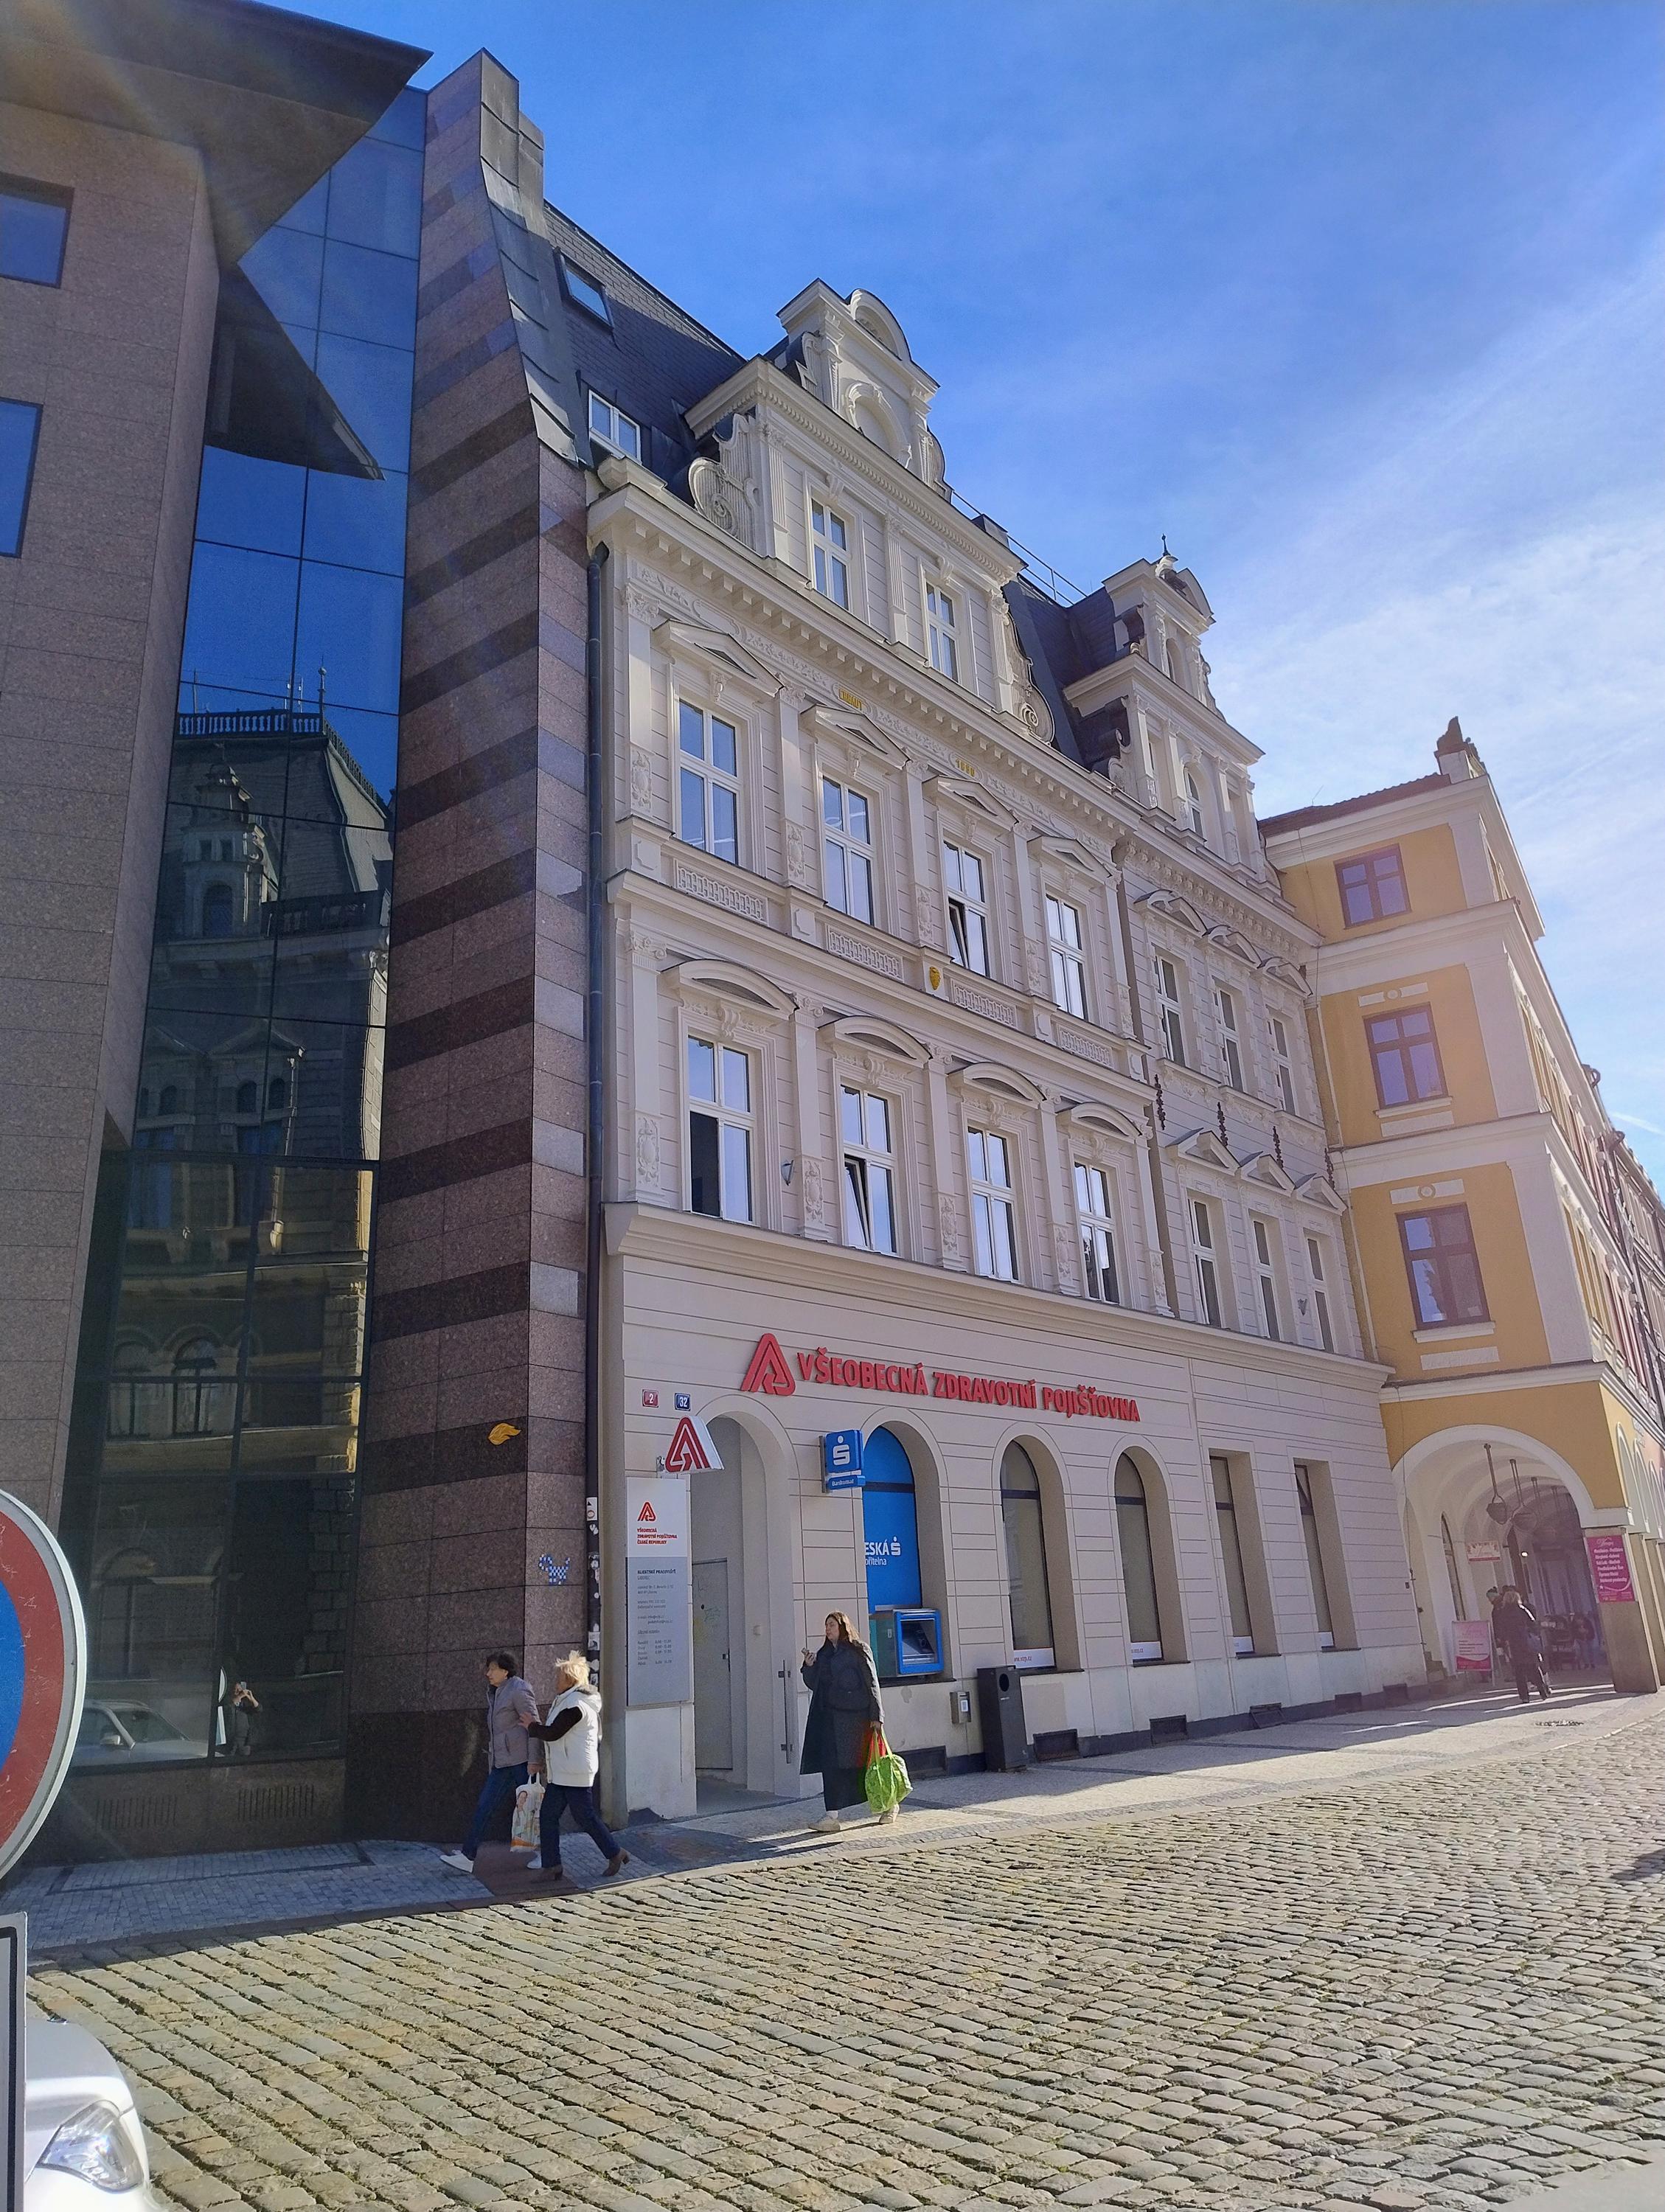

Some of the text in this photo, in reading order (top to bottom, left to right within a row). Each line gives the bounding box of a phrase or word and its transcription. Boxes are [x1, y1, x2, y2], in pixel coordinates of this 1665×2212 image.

[796, 1346, 1141, 1422] VŠEOBECNÁ ZDRAVOTNÍ POJIŠŤOVNA
[649, 1393, 654, 1404] 2
[679, 1396, 688, 1408] 32
[831, 1478, 855, 1486] Bankomat
[864, 1539, 890, 1556] ESKÁ
[865, 1555, 887, 1565] ořitelna
